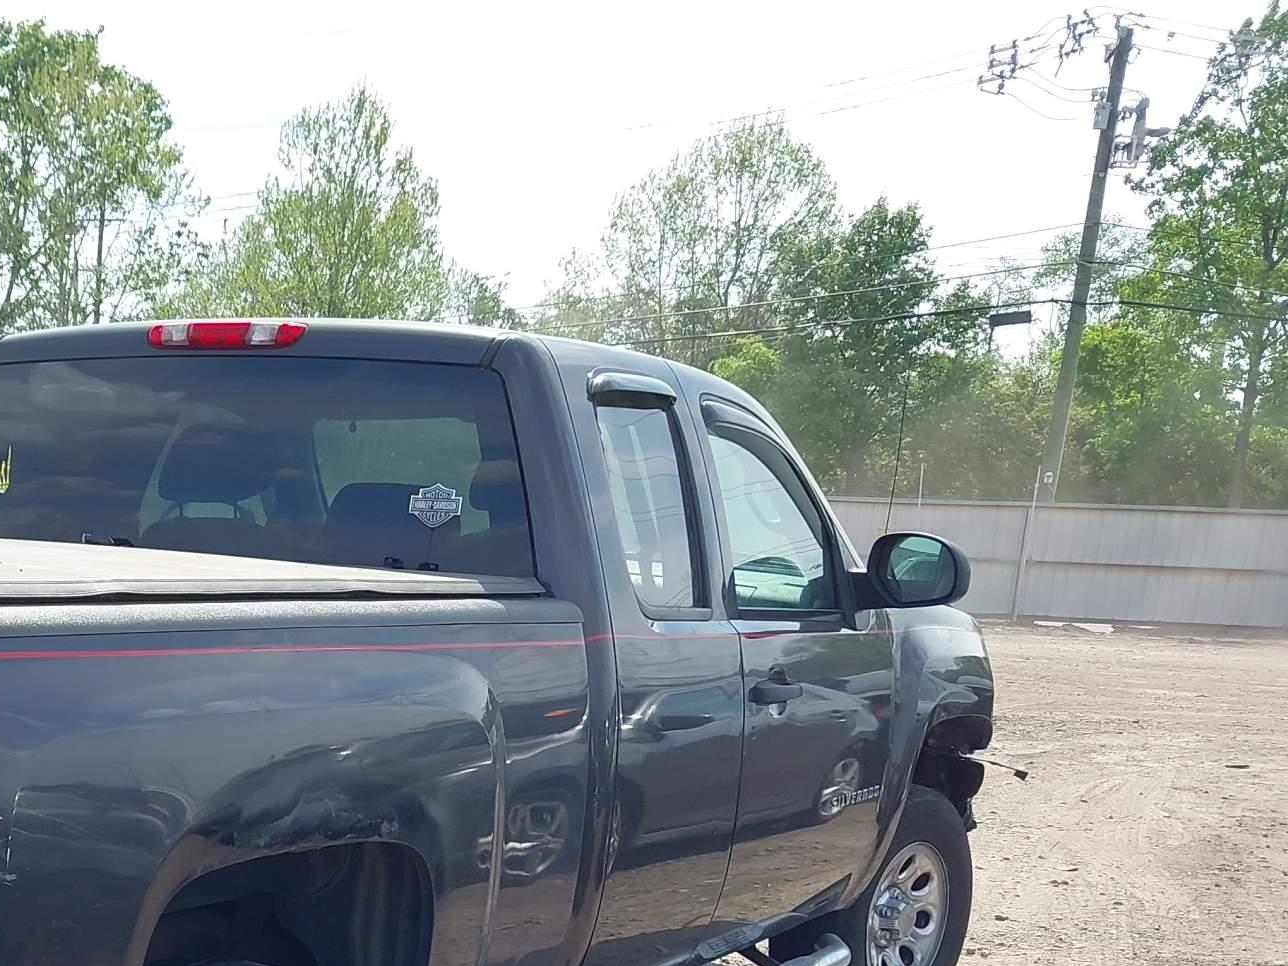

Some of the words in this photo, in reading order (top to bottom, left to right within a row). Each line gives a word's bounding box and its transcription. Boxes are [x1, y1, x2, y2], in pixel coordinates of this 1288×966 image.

[424, 489, 449, 499] MOTOR
[414, 500, 457, 511] HARLEY-DAVIDSON
[422, 511, 446, 522] CYCLES
[830, 784, 881, 810] SILVERADO
